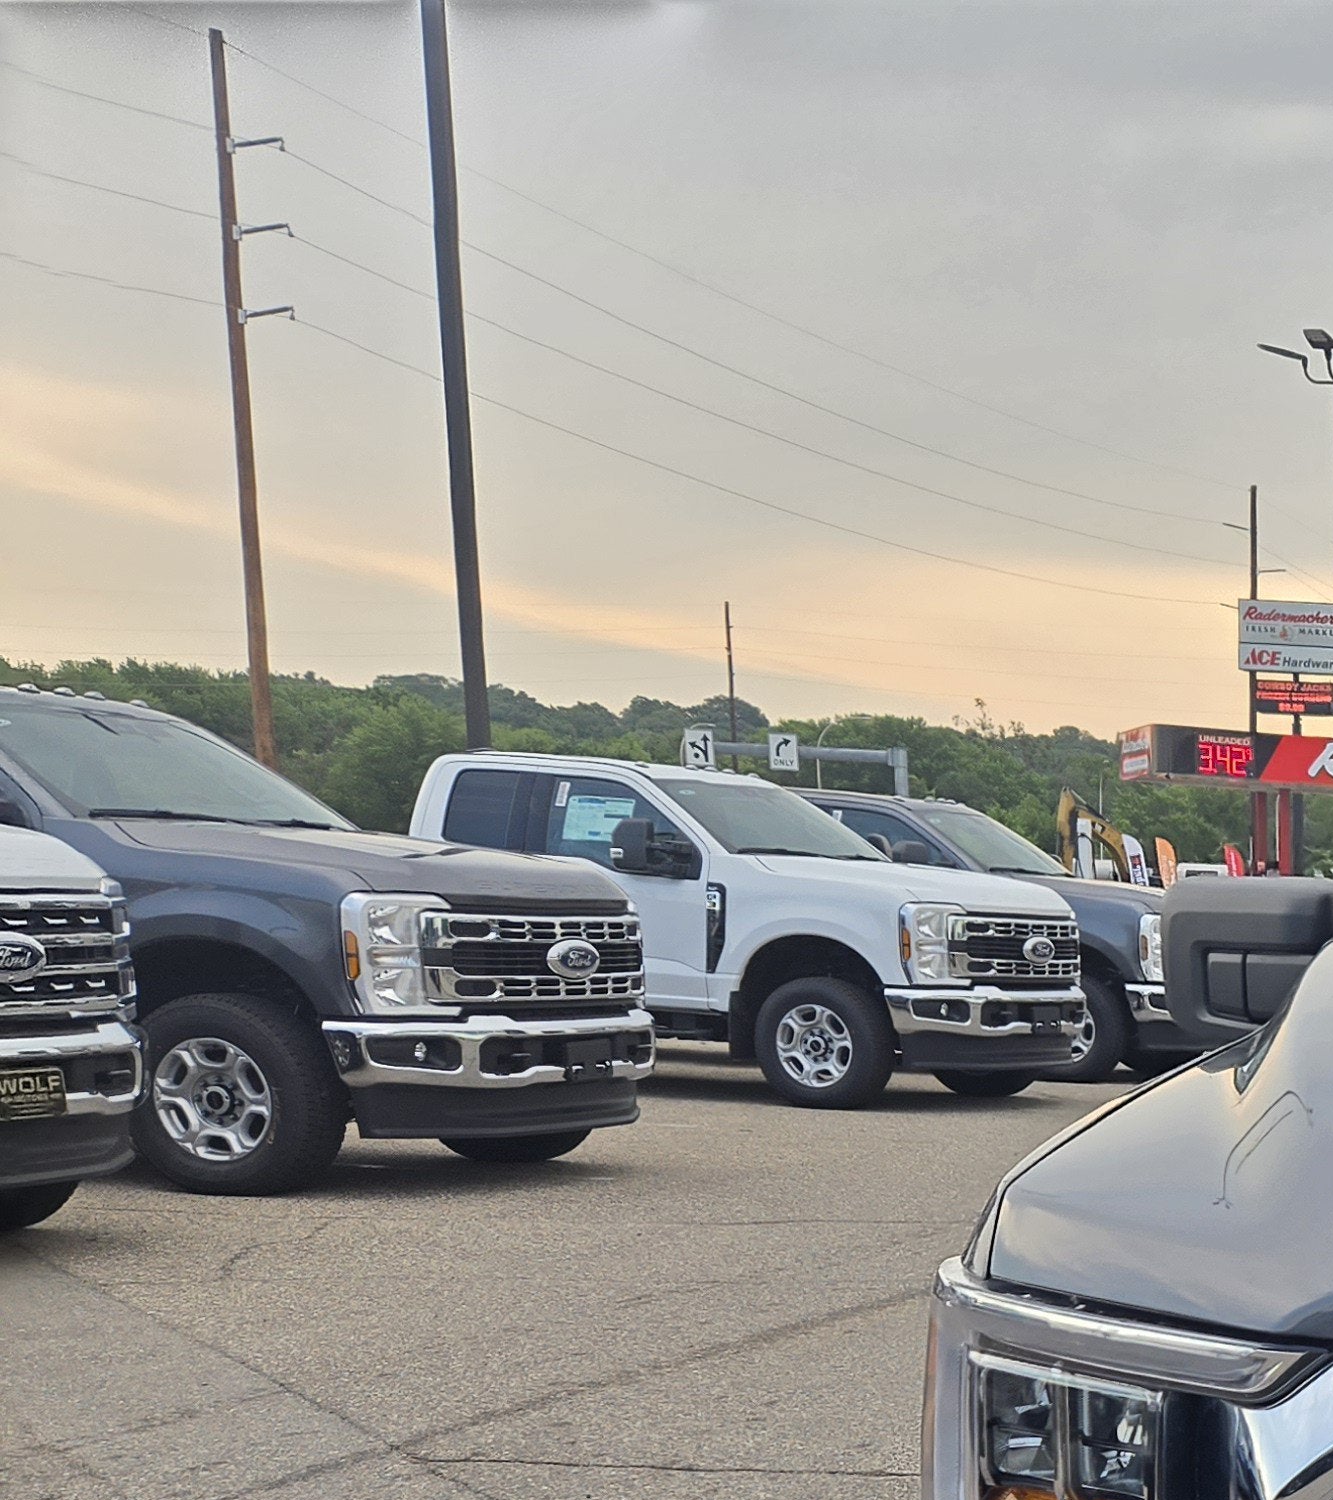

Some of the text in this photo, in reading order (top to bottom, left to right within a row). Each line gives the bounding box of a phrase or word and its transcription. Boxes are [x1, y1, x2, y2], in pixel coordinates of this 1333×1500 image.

[1246, 625, 1276, 634] FRESH
[1244, 648, 1281, 666] ACE
[1199, 734, 1249, 746] UNLEADED
[774, 758, 794, 767] ONLY
[567, 949, 591, 967] Ford
